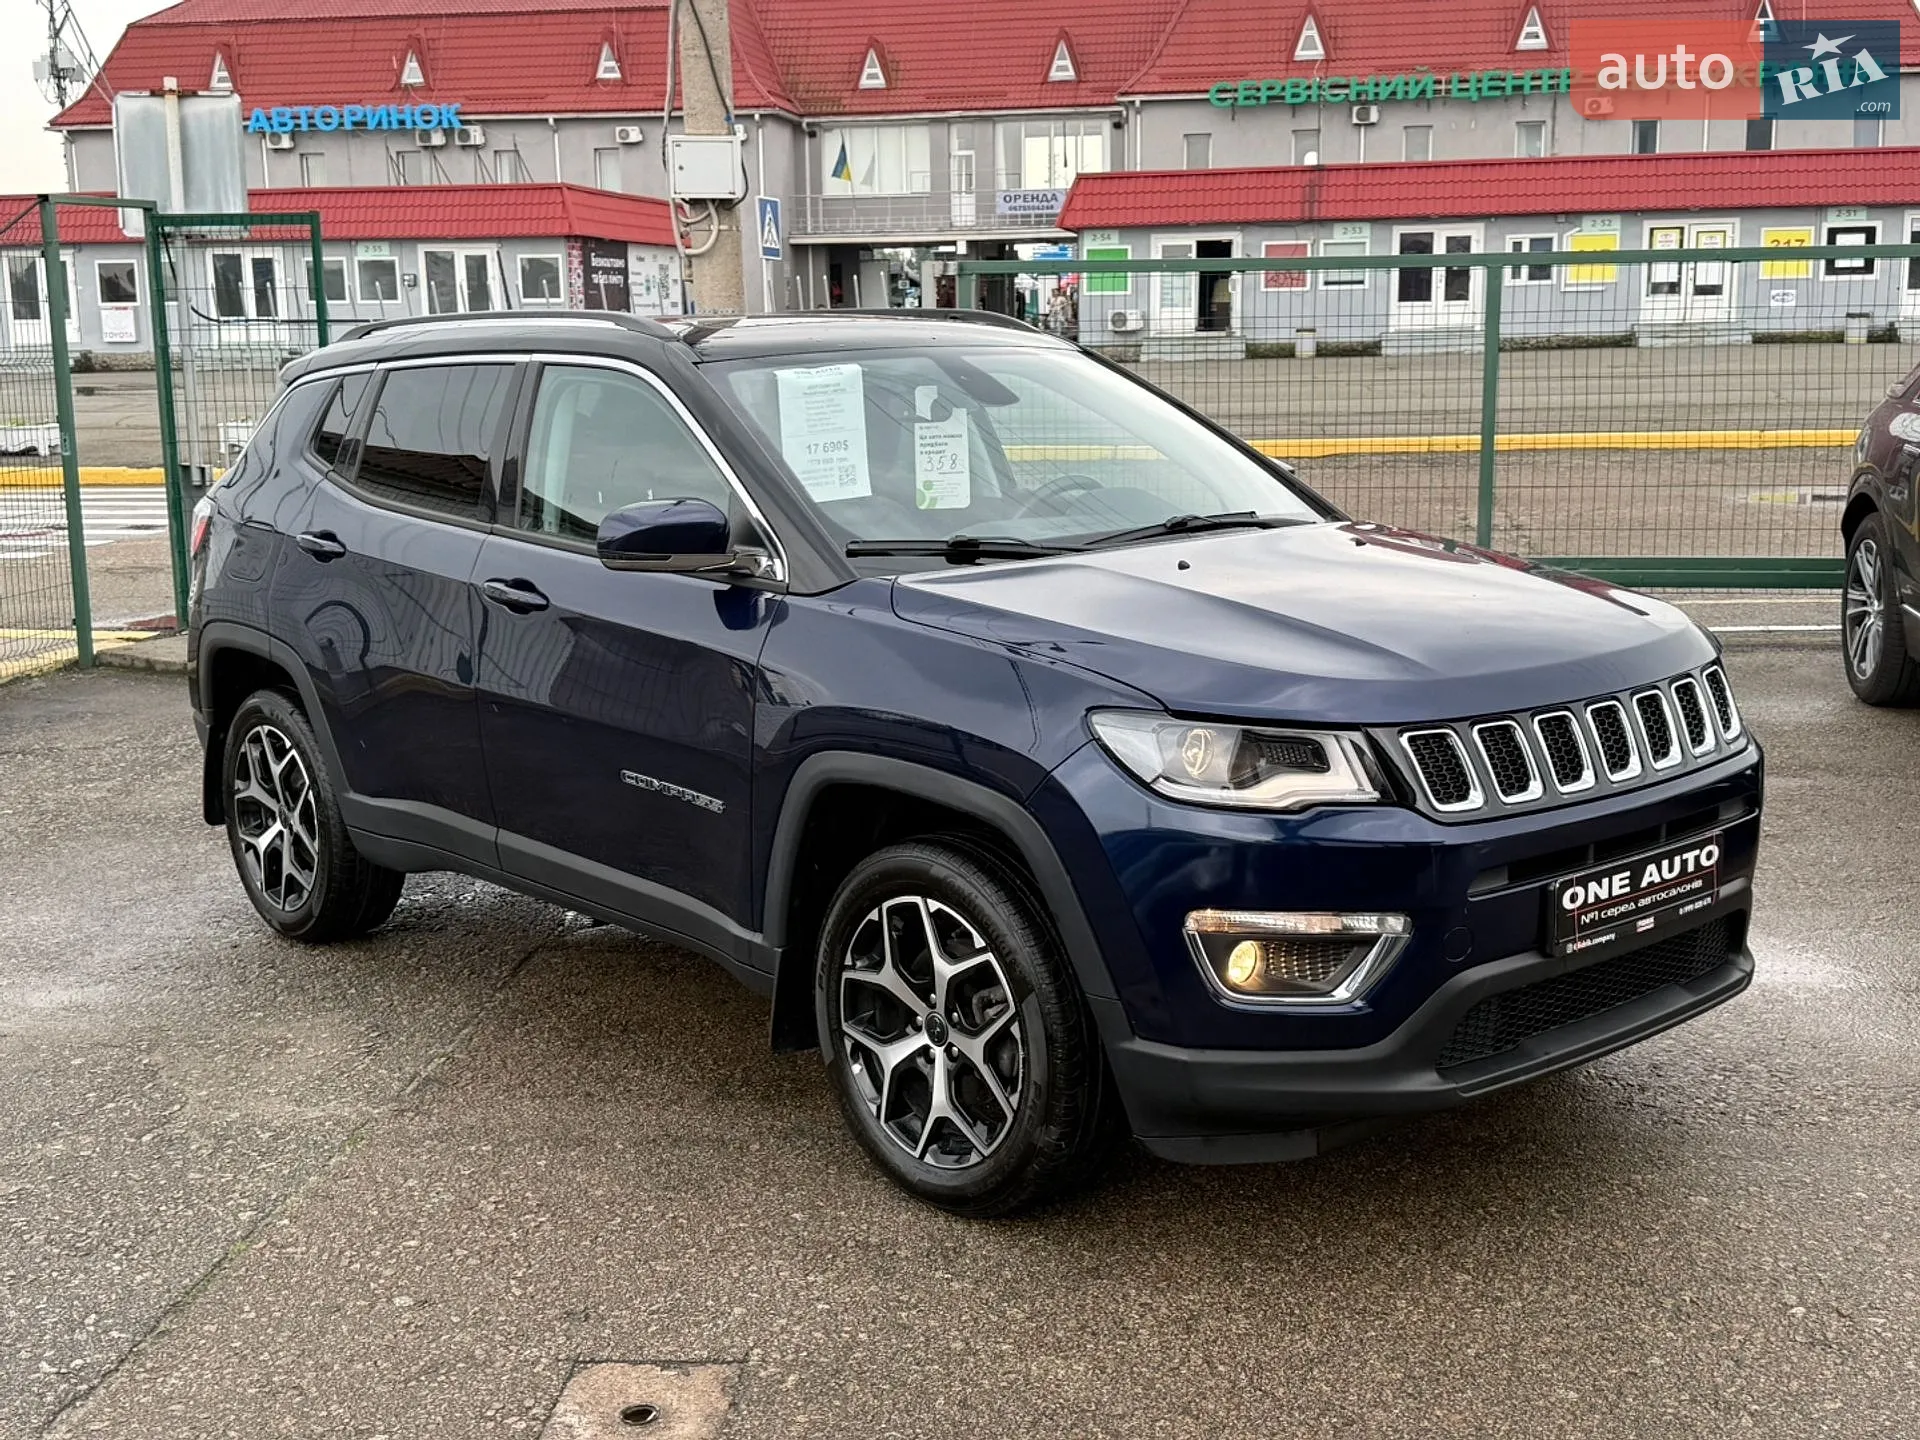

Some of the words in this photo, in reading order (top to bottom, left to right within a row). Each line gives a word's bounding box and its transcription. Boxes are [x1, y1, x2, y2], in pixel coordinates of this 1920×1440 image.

[1208, 66, 1434, 108] СЕРВІСНИЙ
[248, 103, 463, 133] АВТОРИНОК
[1003, 192, 1059, 204] ОРЕНДА
[363, 244, 384, 253] 2-55
[1562, 871, 1631, 910] ONE
[1640, 844, 1720, 888] AUTO
[1601, 902, 1637, 921] серед
[1637, 879, 1703, 908] автосалонів
